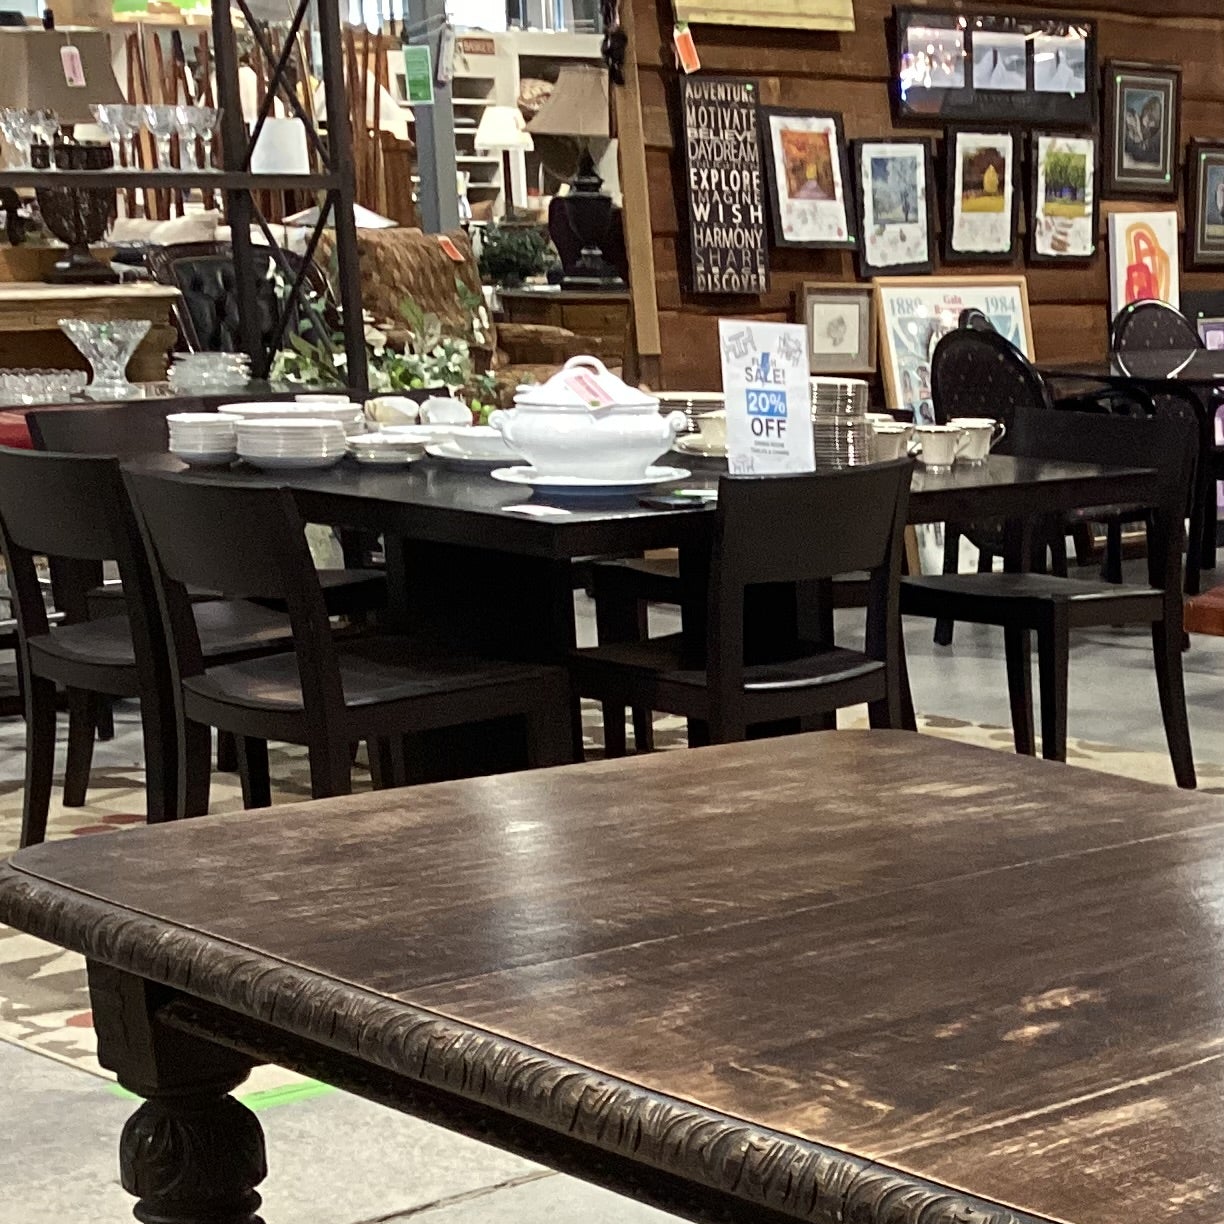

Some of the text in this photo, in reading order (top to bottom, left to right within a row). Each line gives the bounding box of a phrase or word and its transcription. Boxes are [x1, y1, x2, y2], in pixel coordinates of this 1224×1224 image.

[686, 105, 757, 130] MOTIVATE
[687, 128, 757, 143] BELIEVE
[688, 140, 760, 162] DAYDREAM
[690, 168, 760, 191] EXPLORE
[692, 189, 761, 205] IMAGINE
[693, 203, 763, 224] WISH
[694, 225, 763, 248] HARMONY
[695, 248, 764, 268] SHARE
[697, 273, 767, 293] DISCOVER
[985, 296, 1015, 313] 1984
[745, 366, 786, 385] SALE!
[748, 391, 786, 415] 20%
[751, 417, 787, 439] OFF
